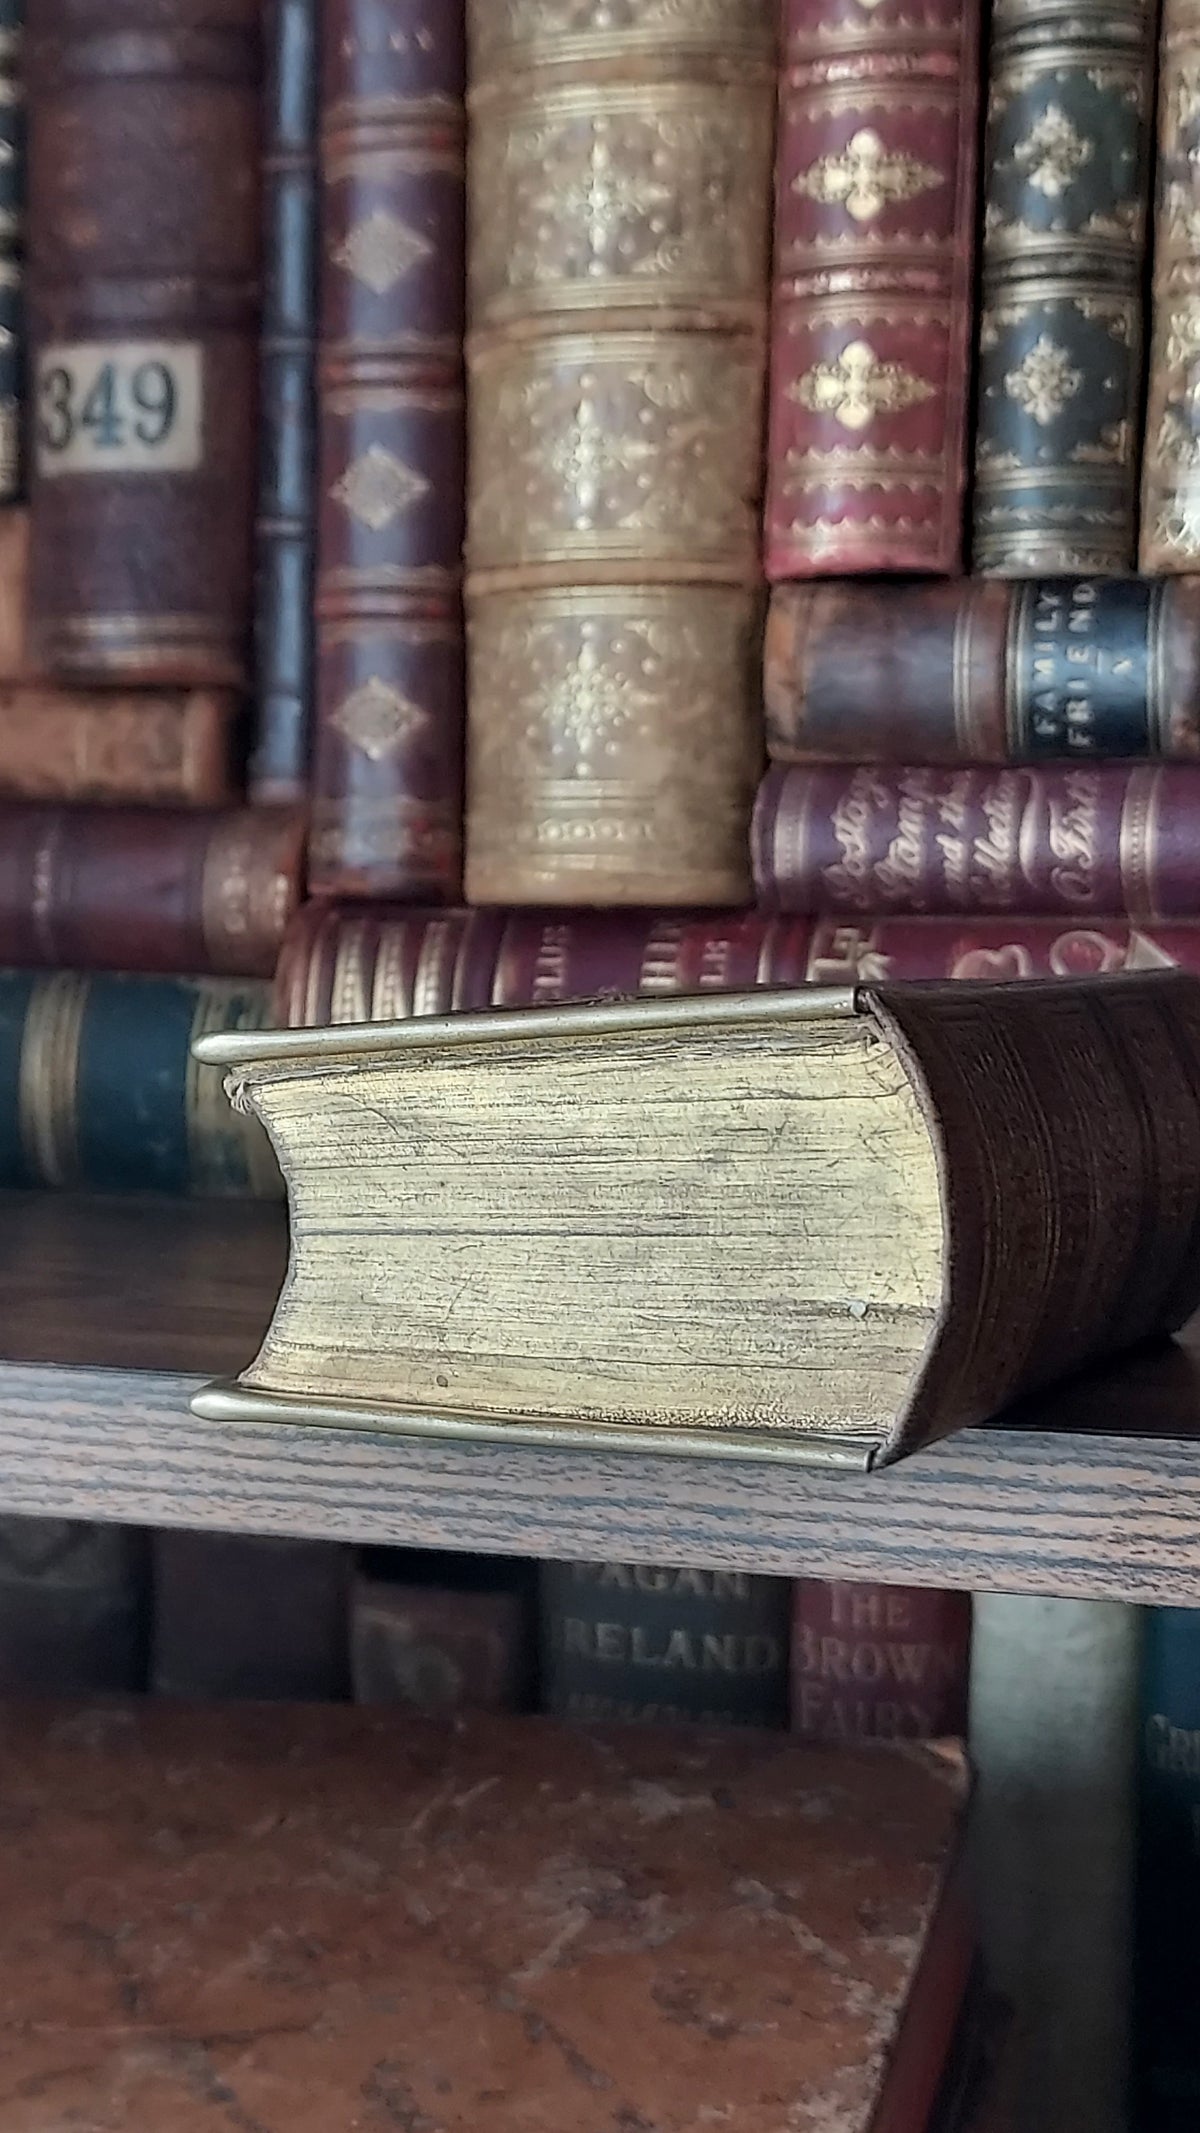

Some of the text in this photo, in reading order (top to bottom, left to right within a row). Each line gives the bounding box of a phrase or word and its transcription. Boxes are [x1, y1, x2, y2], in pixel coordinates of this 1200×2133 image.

[43, 361, 175, 452] 349
[1032, 589, 1061, 735] FAMILY
[1065, 583, 1096, 748] FRIEND
[823, 1580, 911, 1628] THE
